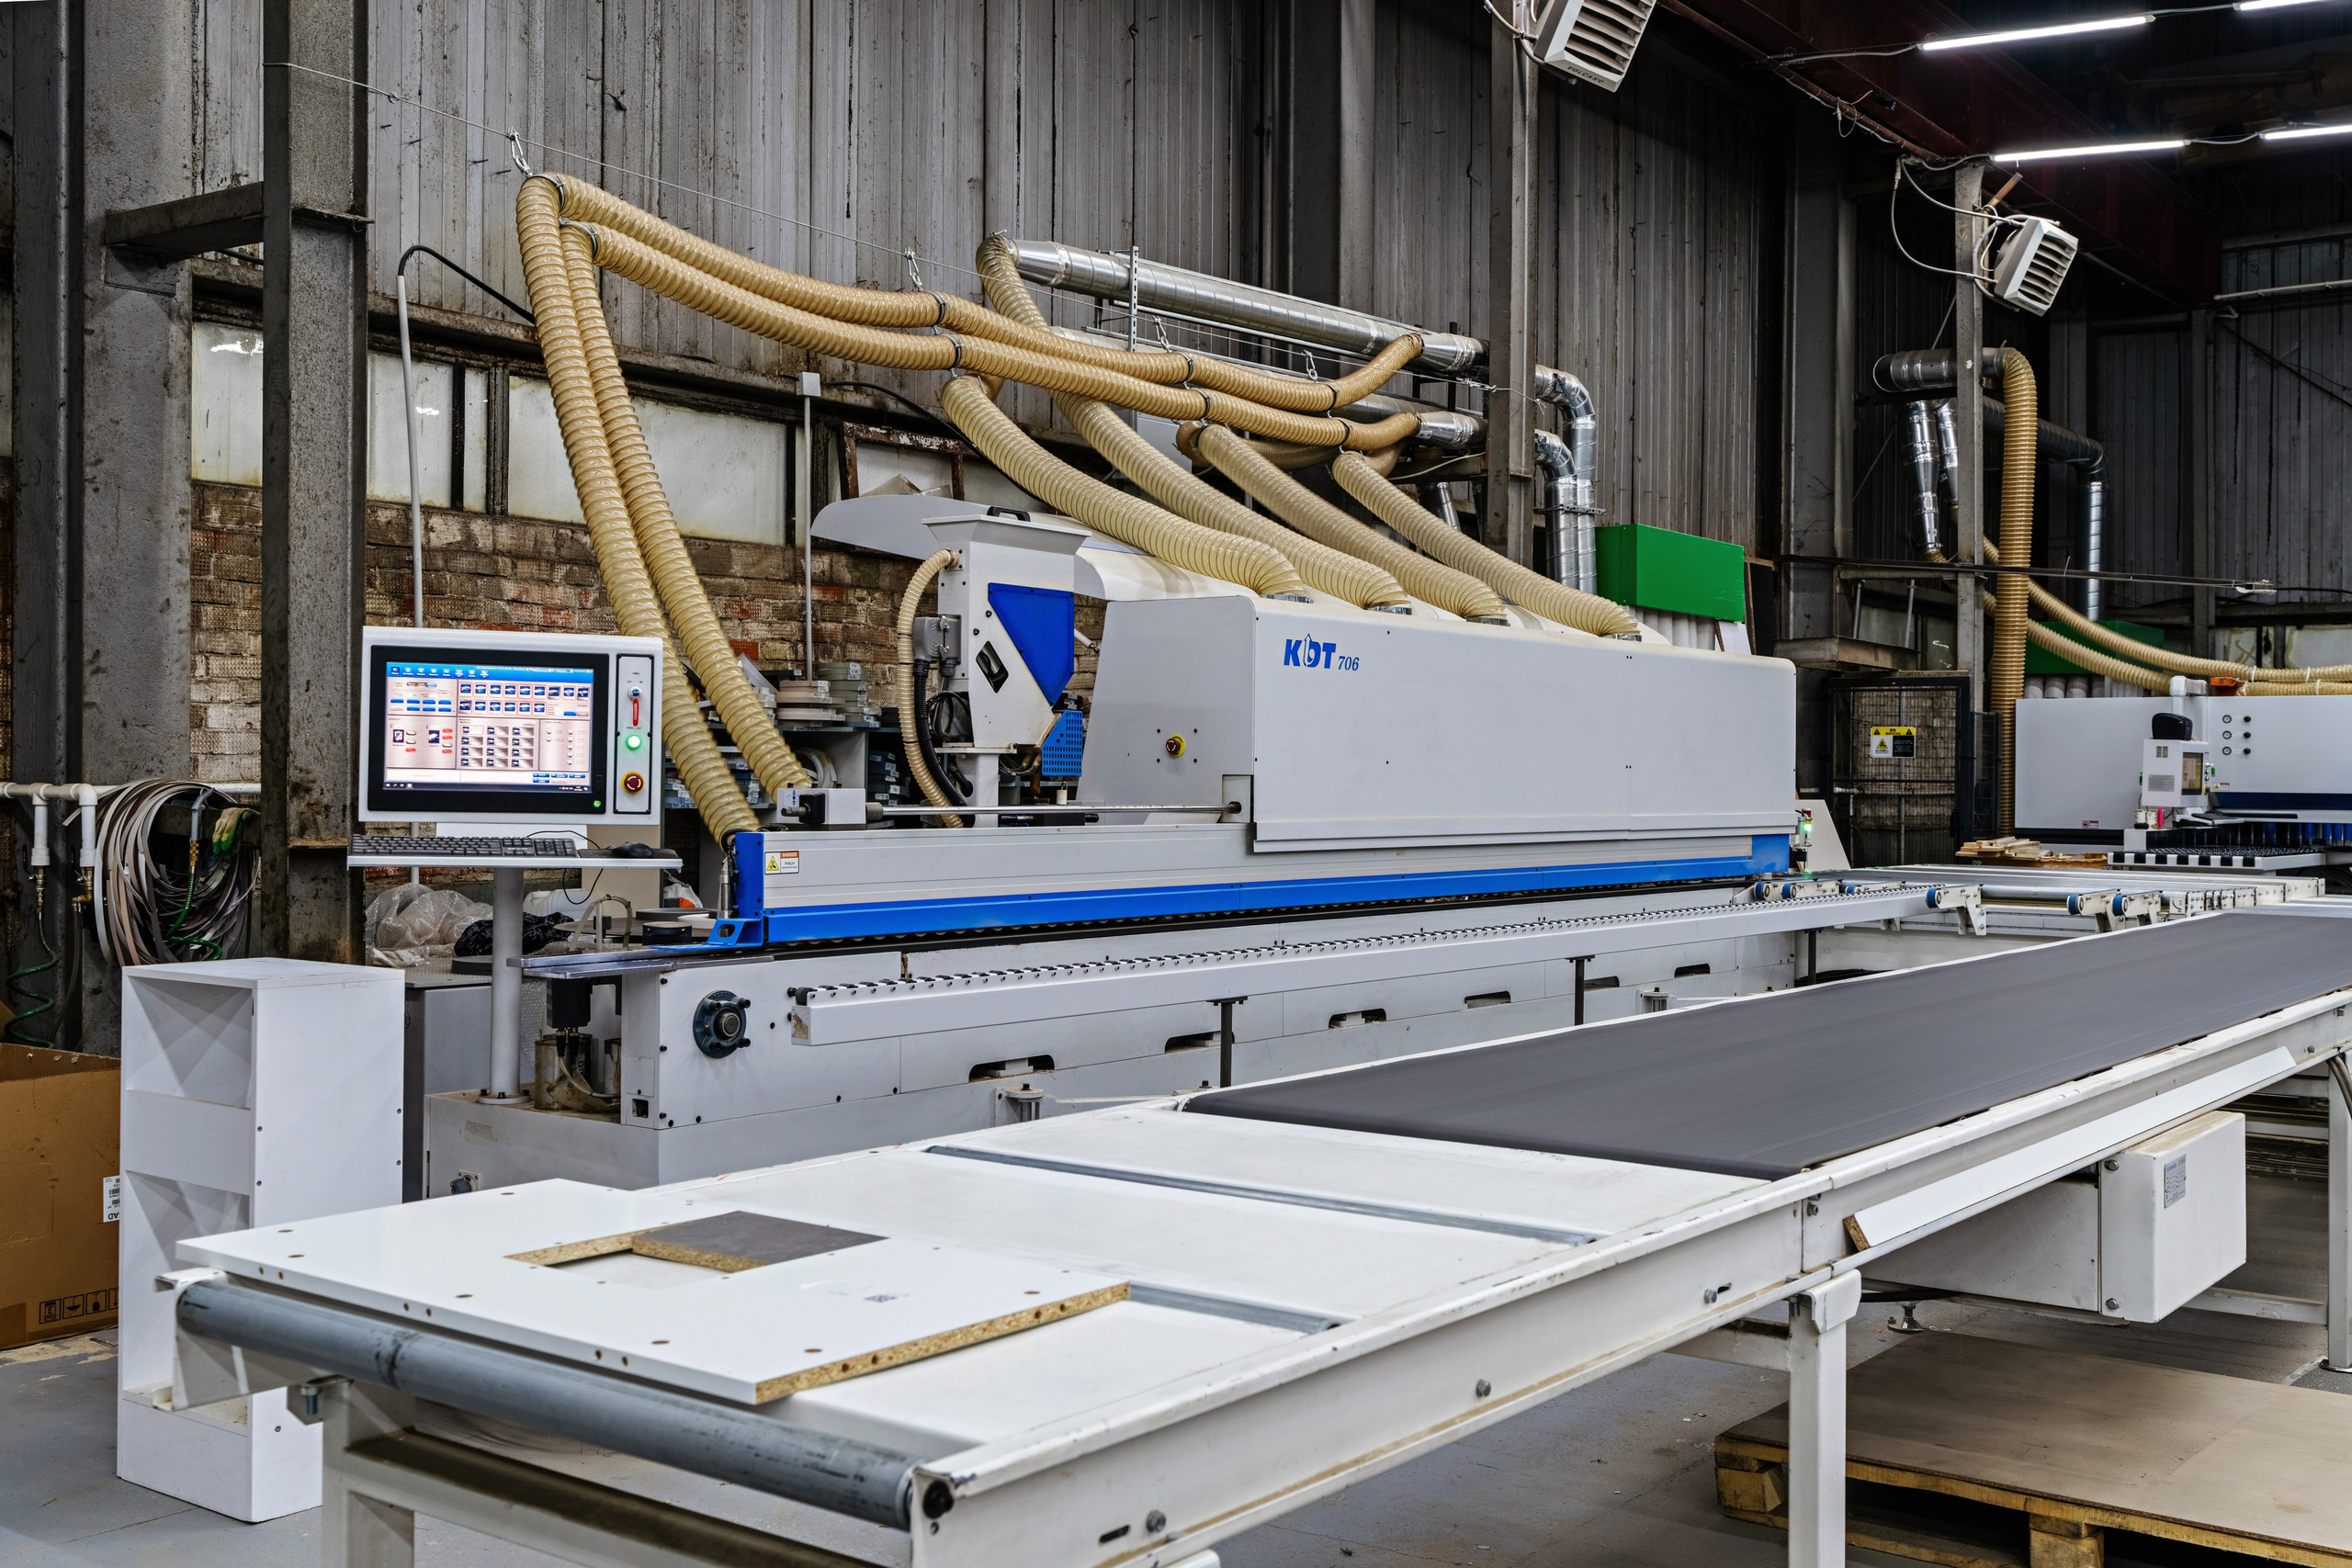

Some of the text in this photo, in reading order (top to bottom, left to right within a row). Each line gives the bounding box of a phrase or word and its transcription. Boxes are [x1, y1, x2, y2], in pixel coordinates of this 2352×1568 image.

[1567, 65, 1604, 84] VOLCANO
[1283, 634, 1360, 671] KDT 706
[107, 1212, 120, 1221] AD
